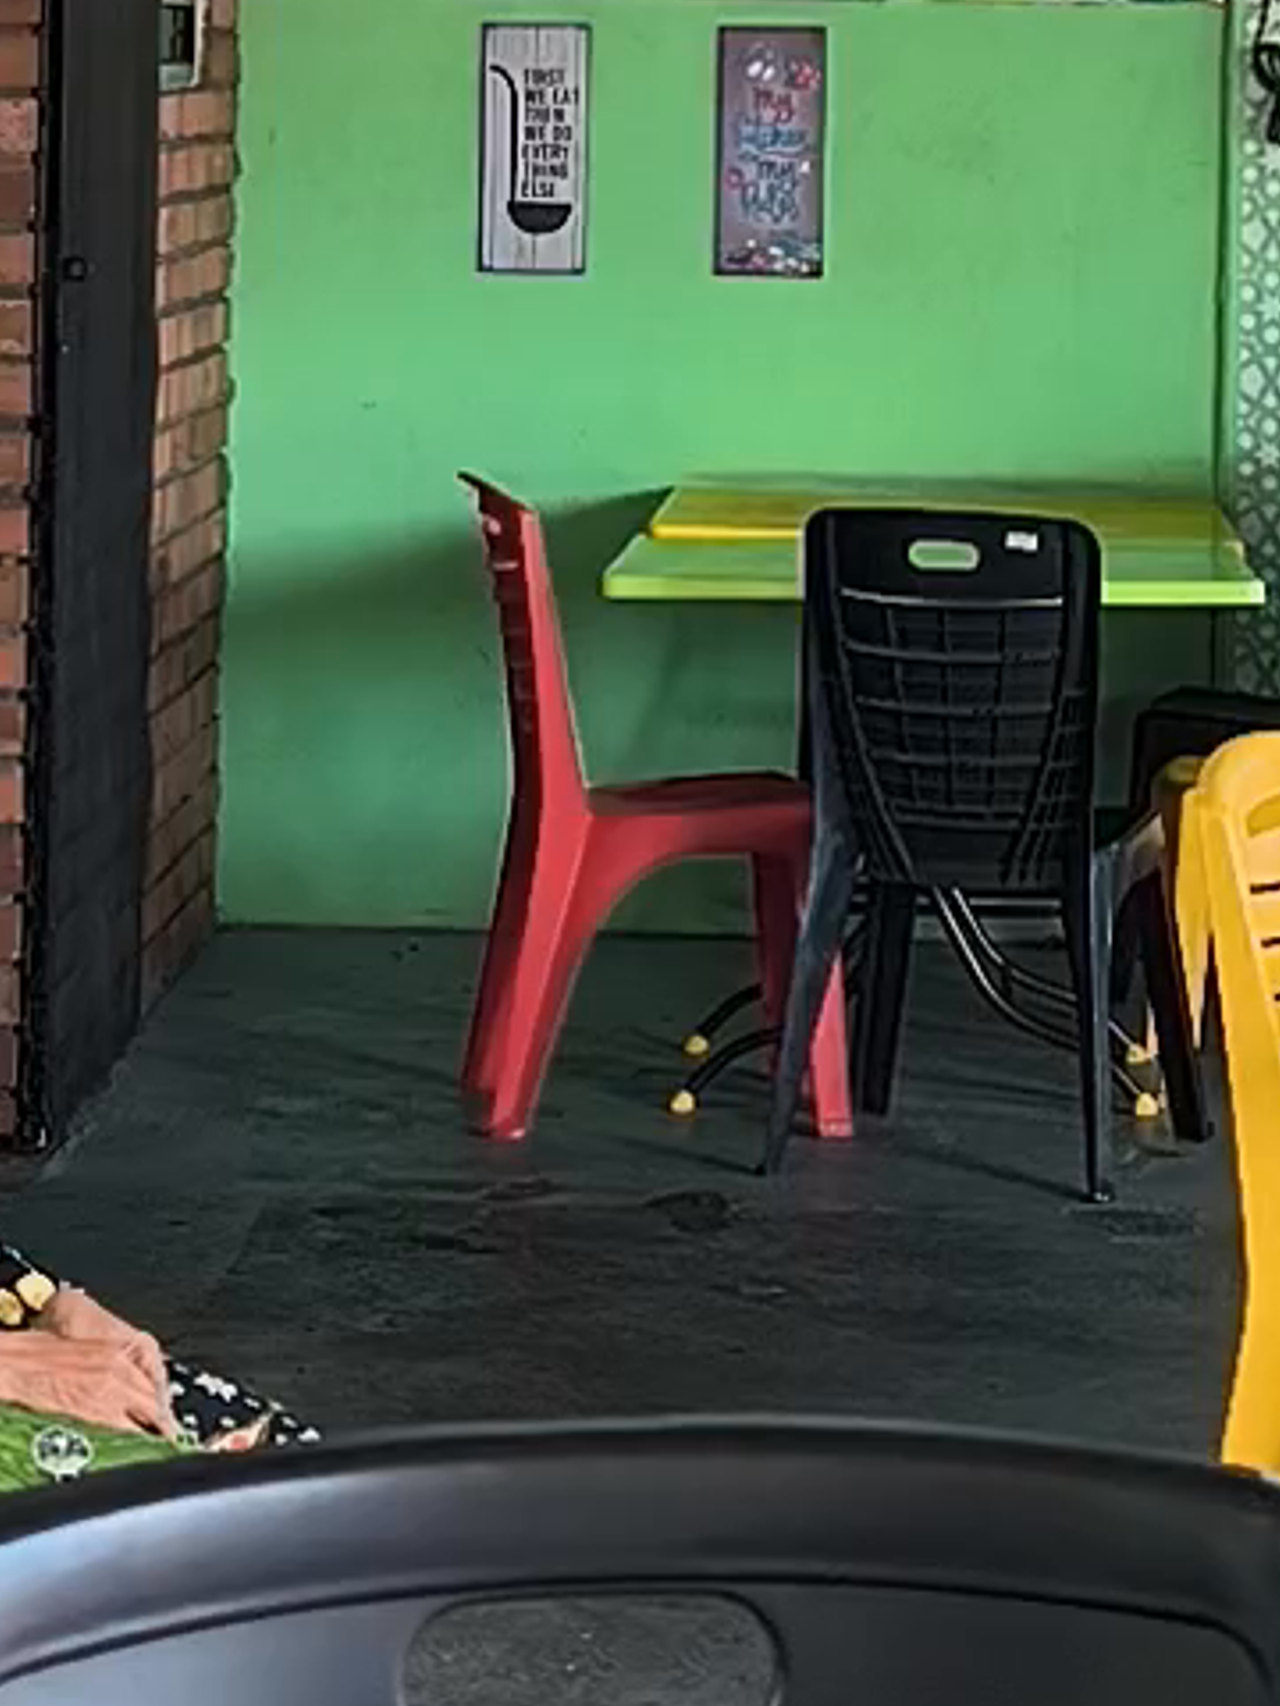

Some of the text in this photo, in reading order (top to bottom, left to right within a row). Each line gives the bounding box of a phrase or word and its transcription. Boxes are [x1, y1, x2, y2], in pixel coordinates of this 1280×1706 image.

[523, 68, 565, 86] FIRST
[524, 87, 579, 105] WE EAT
[524, 125, 572, 141] WE DO
[521, 143, 569, 160] EVERY
[523, 162, 568, 179] THING
[521, 181, 555, 197] ELSE
